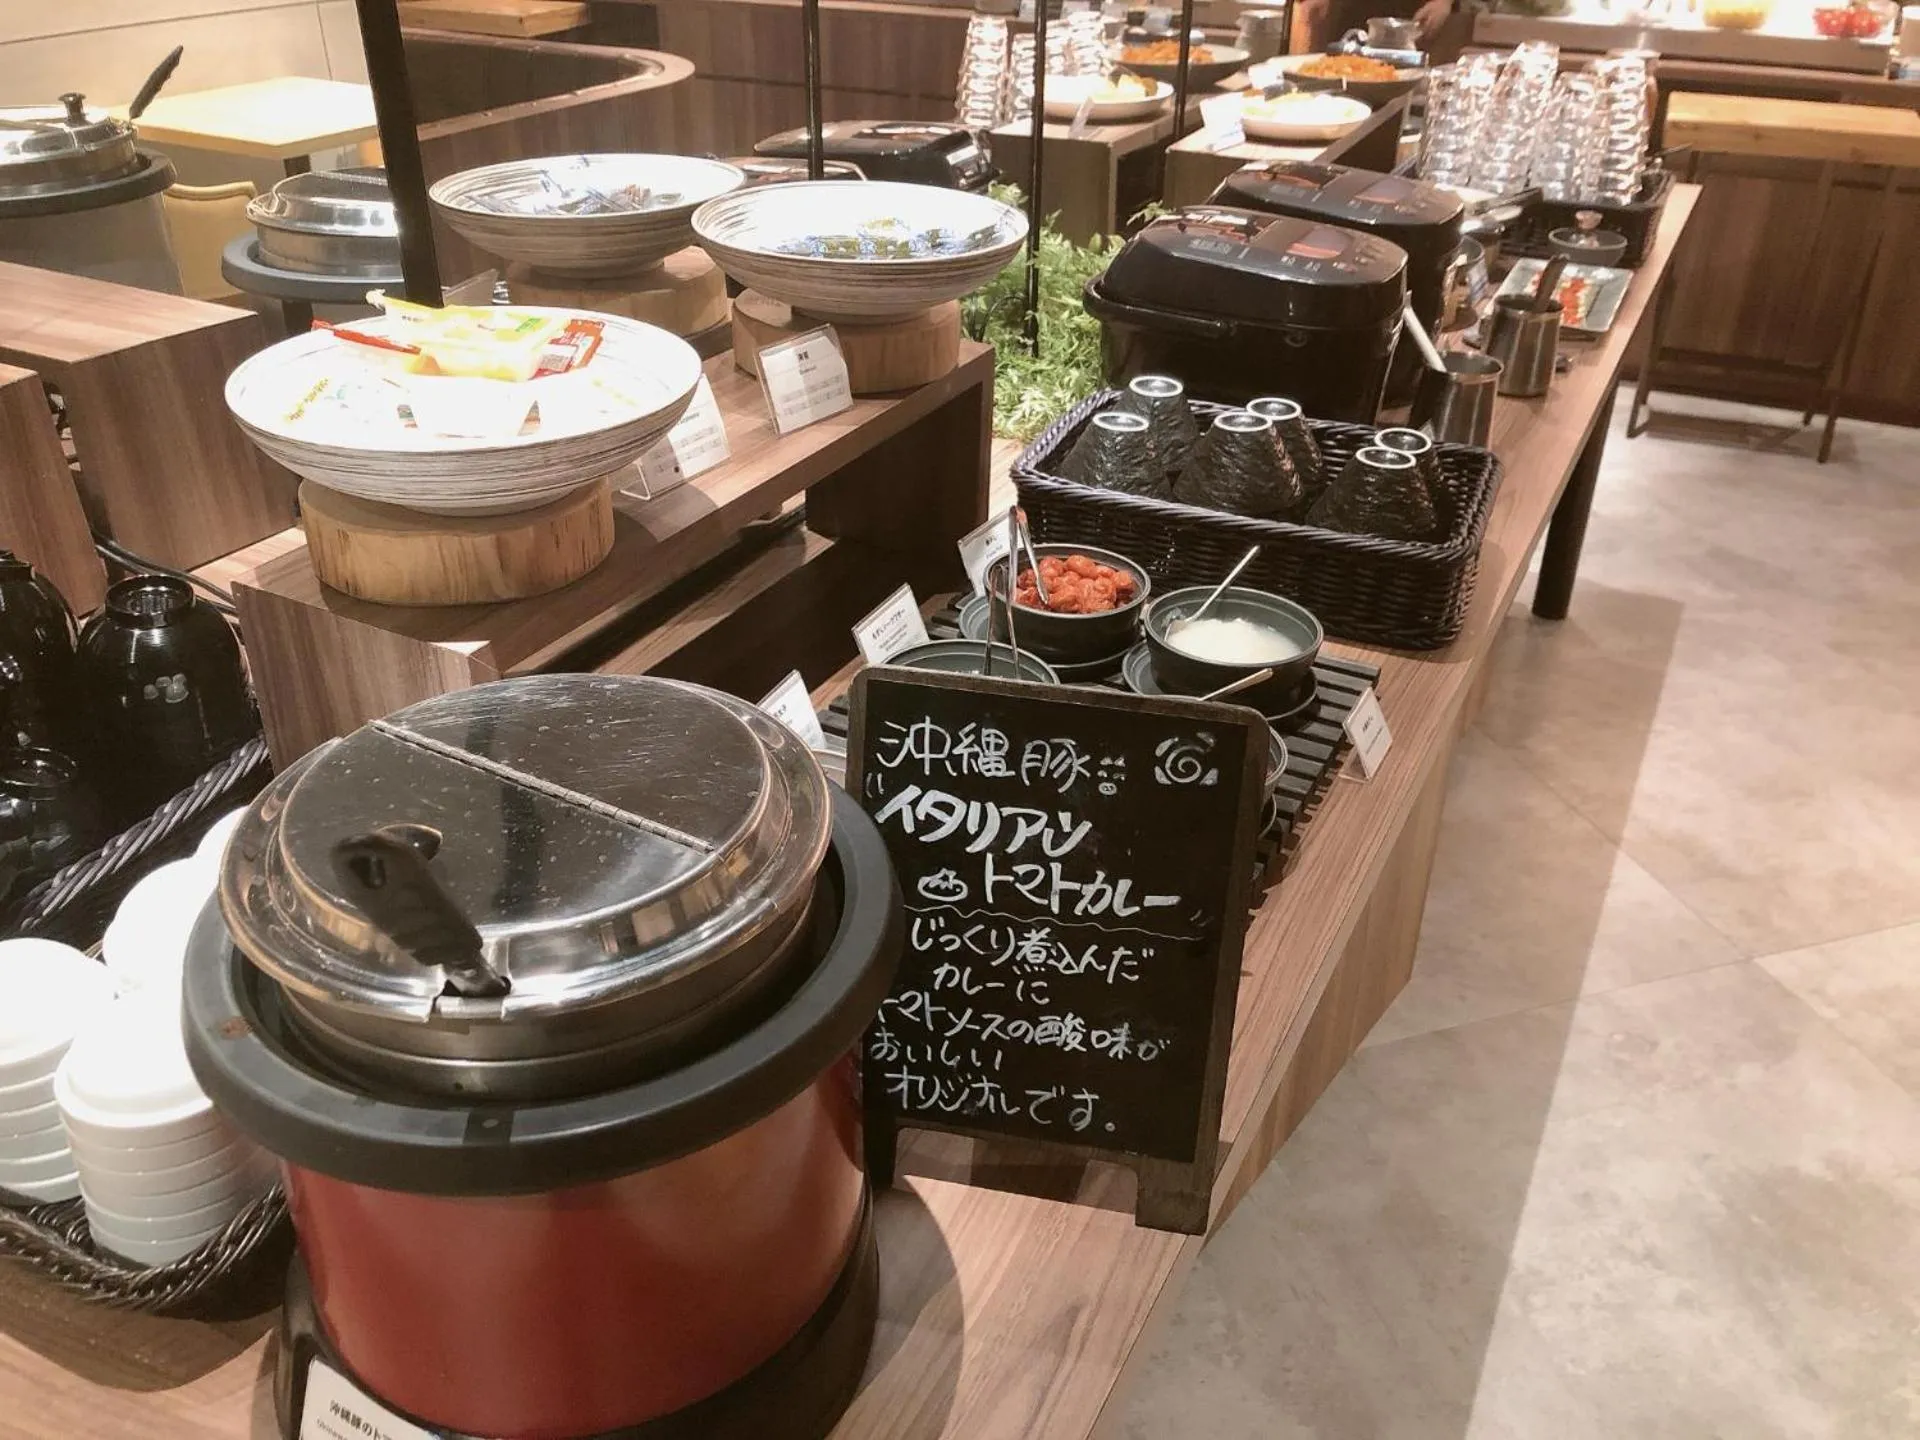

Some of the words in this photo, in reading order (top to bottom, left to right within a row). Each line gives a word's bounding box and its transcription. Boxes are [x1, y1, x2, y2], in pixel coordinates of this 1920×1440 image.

[876, 715, 1091, 794] 沖縄豚
[985, 852, 1182, 917] トマトカレー
[911, 916, 1154, 984] じっくり煮込んだ
[933, 963, 1050, 1005] カレーに
[870, 1026, 1003, 1071] おいしい
